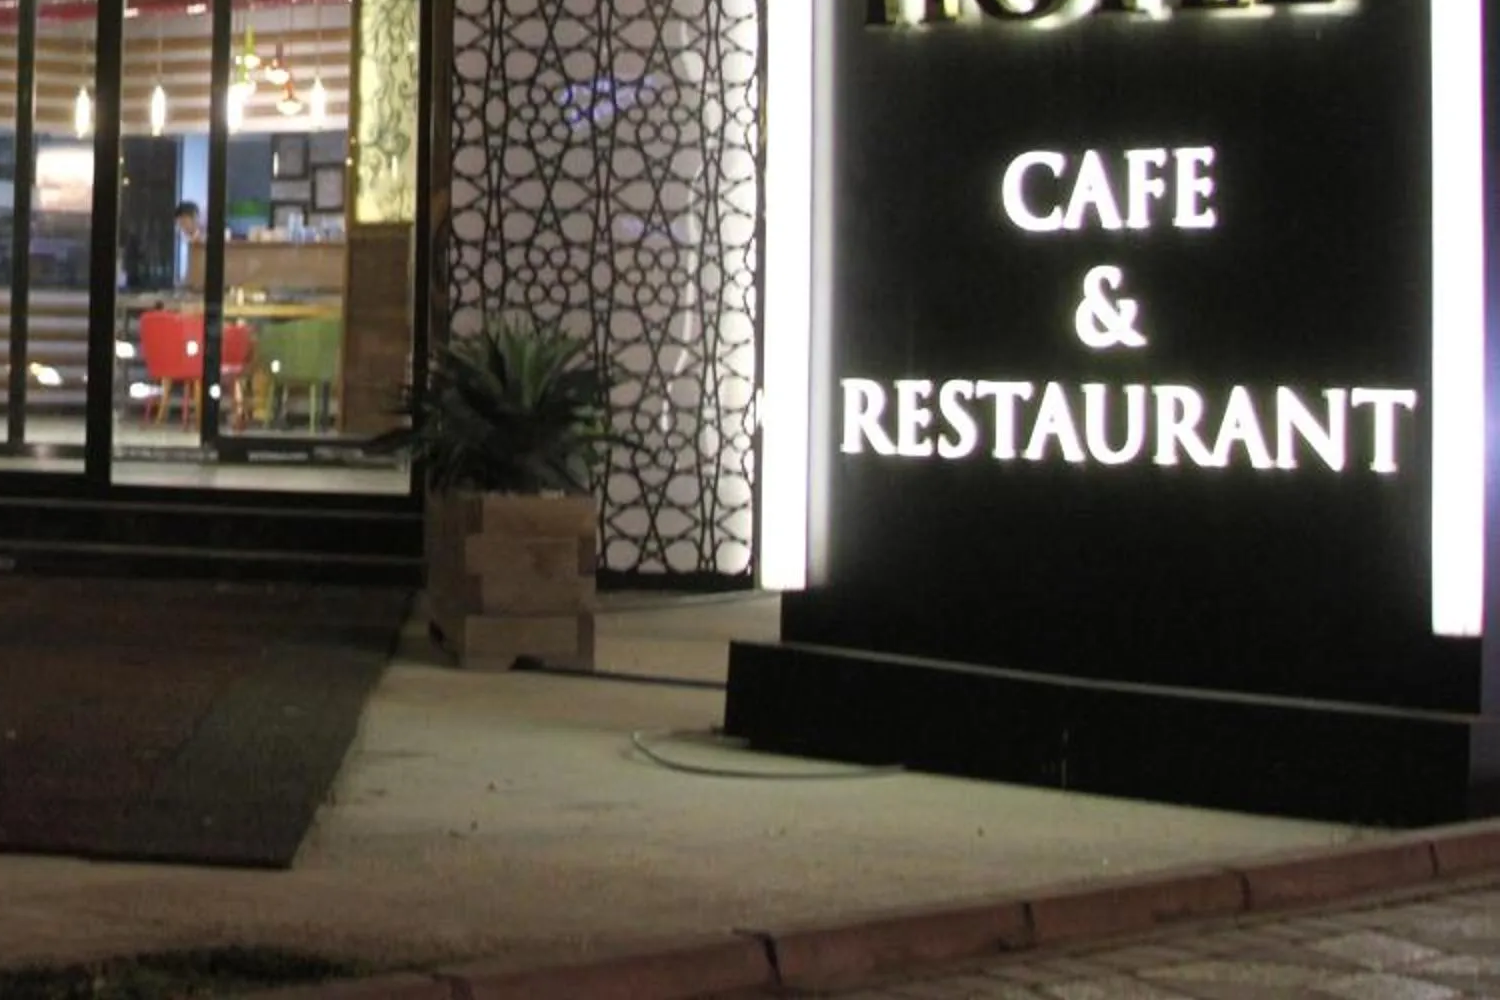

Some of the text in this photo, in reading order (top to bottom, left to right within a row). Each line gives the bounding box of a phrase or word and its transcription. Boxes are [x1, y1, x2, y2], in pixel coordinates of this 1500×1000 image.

[1002, 146, 1217, 232] CAFE
[1074, 265, 1147, 348] &
[840, 378, 1417, 474] RESTAURANT
